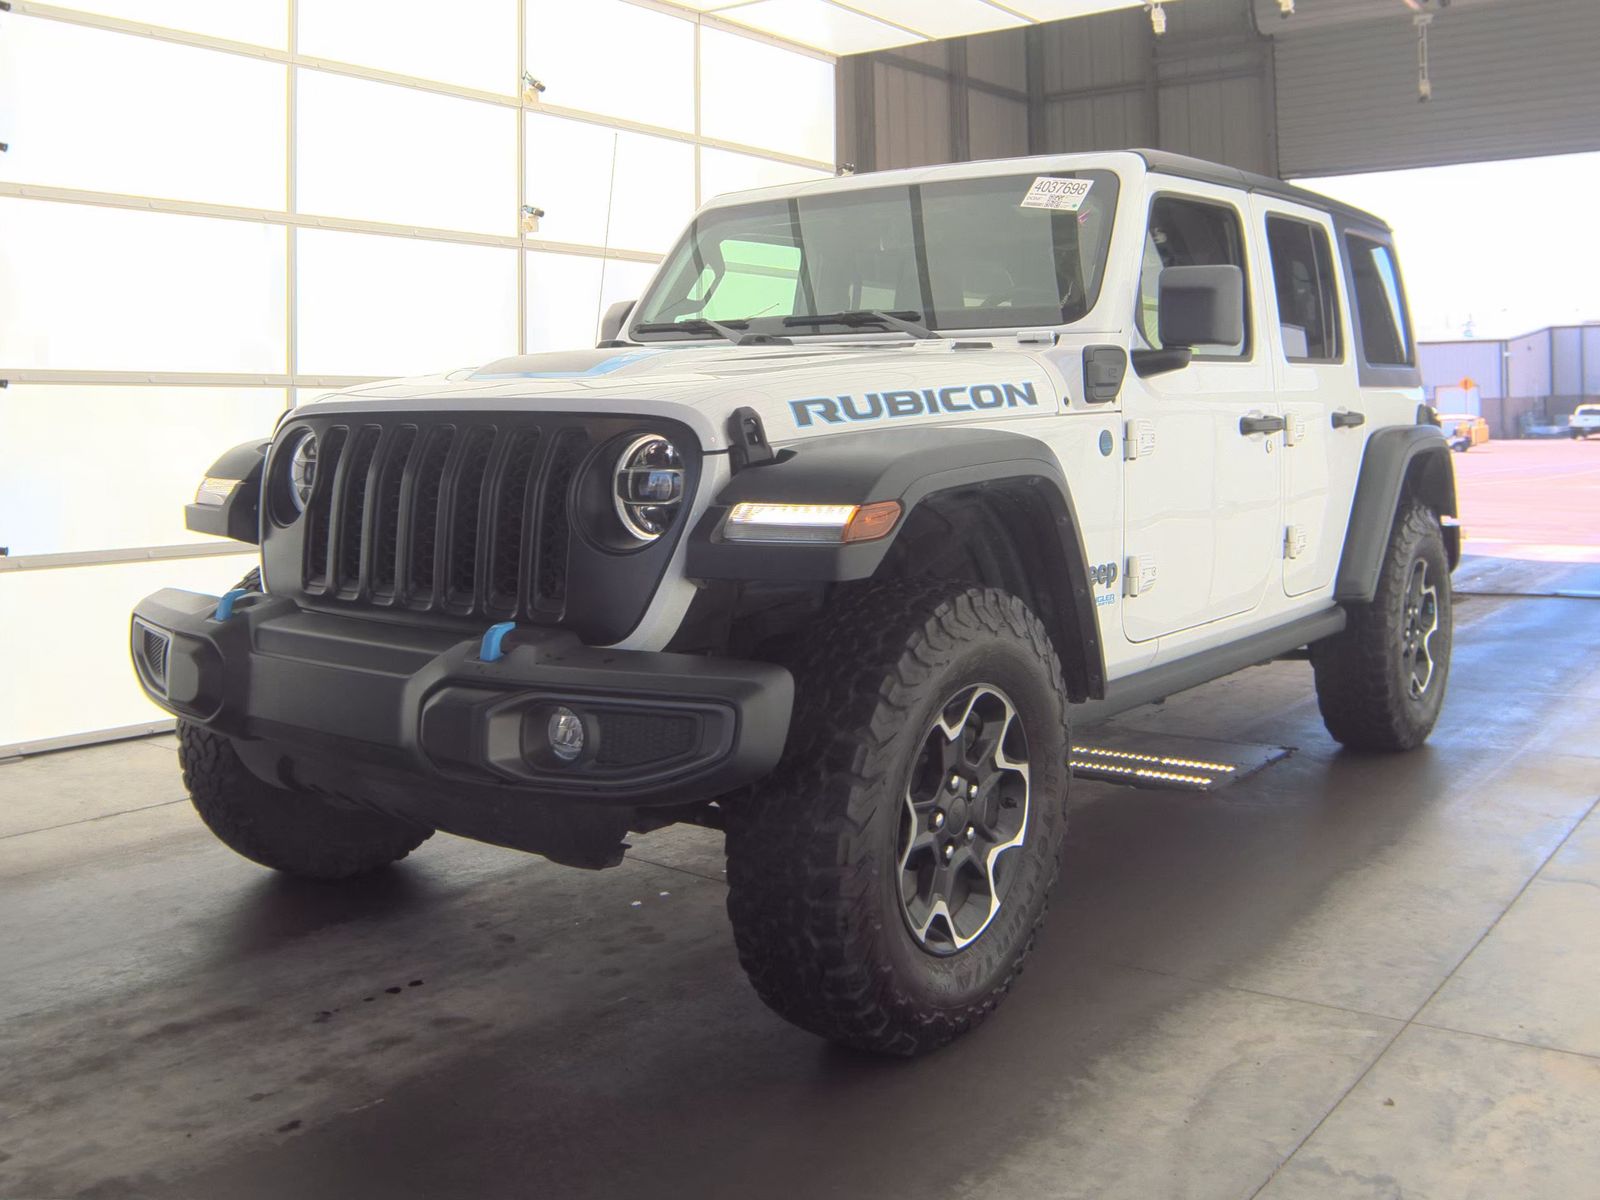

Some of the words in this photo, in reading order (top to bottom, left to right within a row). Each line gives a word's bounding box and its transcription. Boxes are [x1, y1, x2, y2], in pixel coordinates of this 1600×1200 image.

[1034, 180, 1088, 195] 4037698
[788, 381, 1039, 428] RUBICON
[1089, 562, 1117, 589] eep
